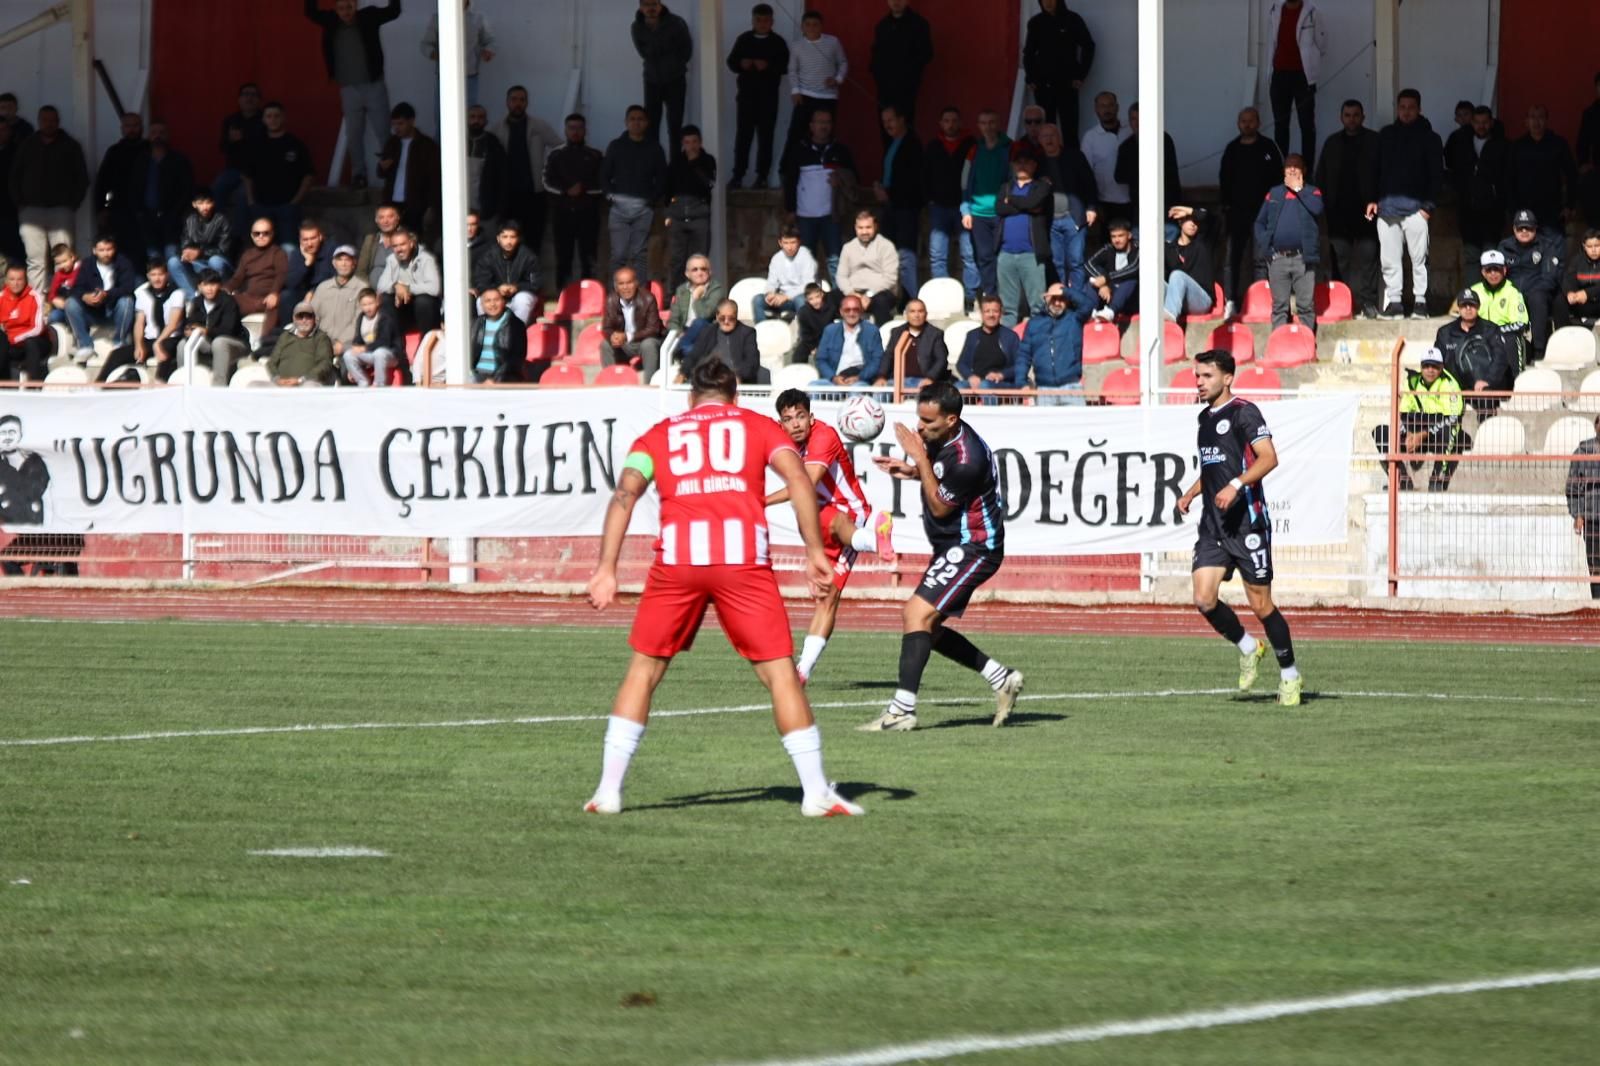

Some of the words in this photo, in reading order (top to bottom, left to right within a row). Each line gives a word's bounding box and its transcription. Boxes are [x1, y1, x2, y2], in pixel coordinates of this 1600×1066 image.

[53, 423, 346, 506] "UĞRUNDA
[378, 413, 617, 518] ÇEKİLEN
[667, 420, 747, 476] 50
[926, 556, 959, 587] 22
[1250, 548, 1268, 569] 17
